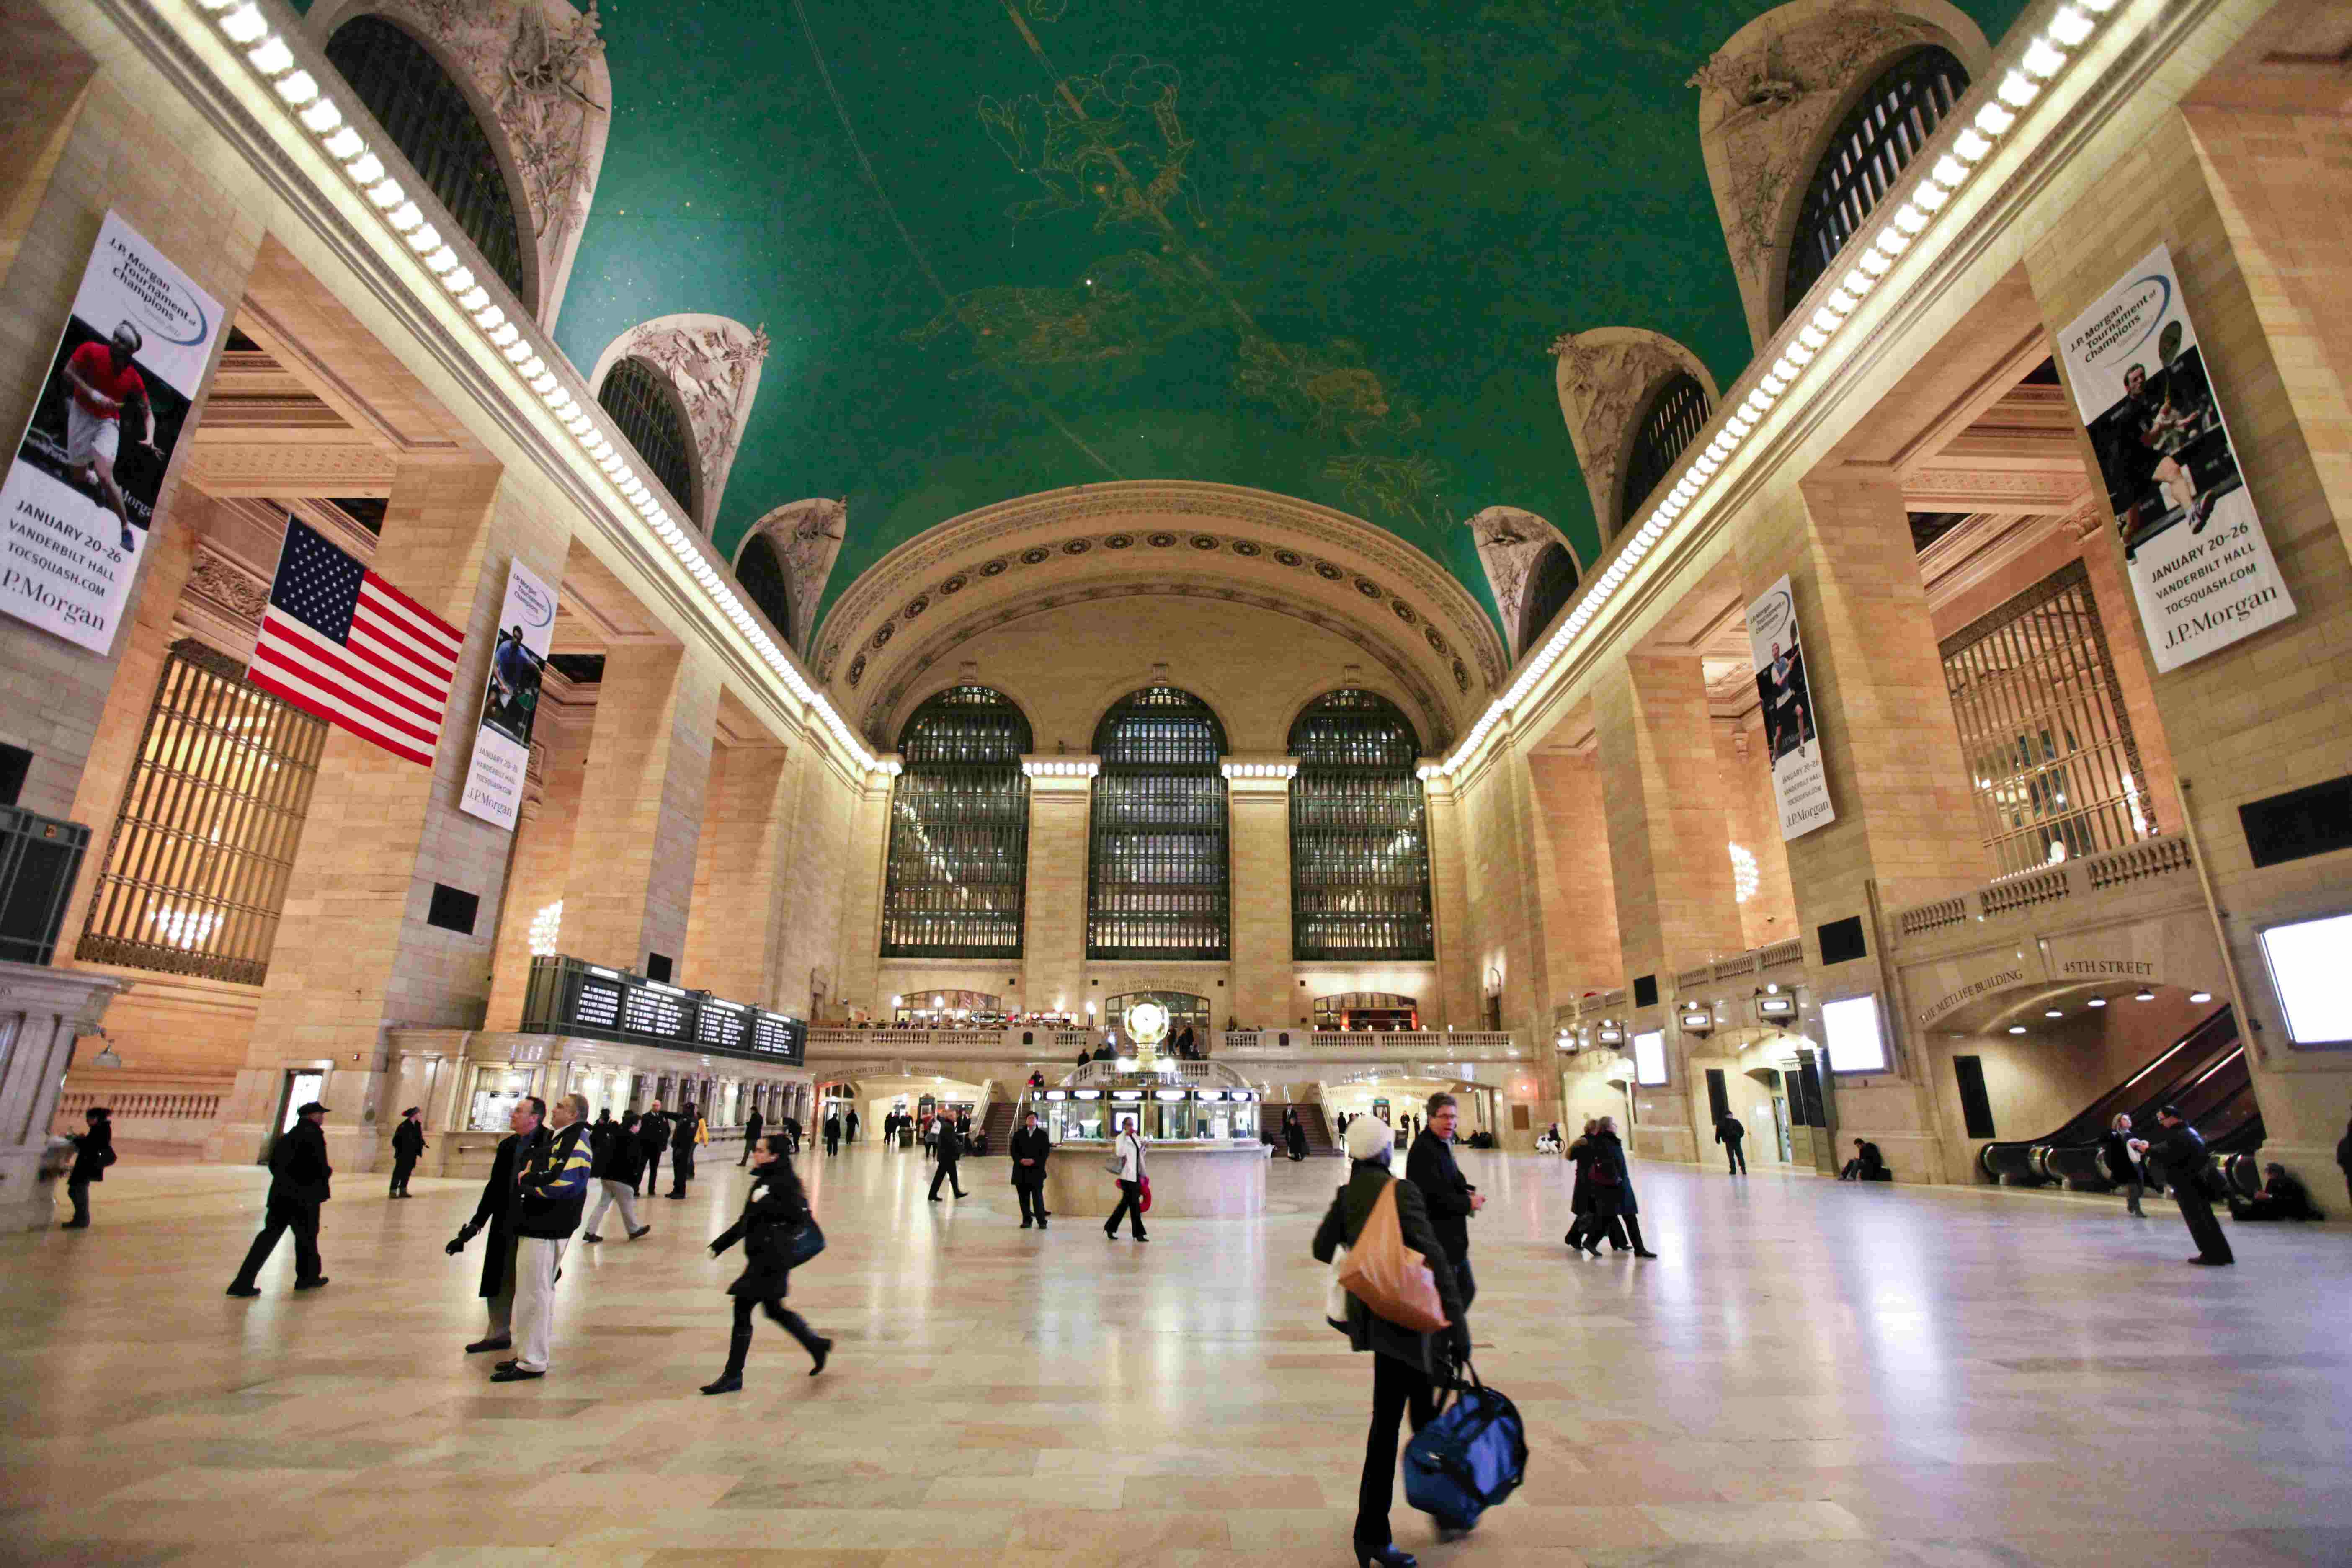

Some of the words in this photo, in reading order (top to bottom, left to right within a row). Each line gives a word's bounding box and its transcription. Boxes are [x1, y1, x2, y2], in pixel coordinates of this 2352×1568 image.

[108, 237, 126, 256] J.P.
[128, 252, 170, 292] Morgan
[124, 261, 188, 320] Tournament
[113, 266, 174, 322] Champions
[2085, 305, 2123, 339] Morgan
[2086, 294, 2148, 349] Tournament
[2085, 315, 2141, 363] Champions
[10, 517, 85, 565] VANDERBILT
[88, 560, 114, 582] HALL
[16, 500, 83, 541] JANUARY
[84, 535, 121, 563] 20-26
[2152, 544, 2205, 583] JANUARY
[2208, 521, 2249, 551] 20-26
[8, 541, 105, 597] TOCSQUASH.COM
[2156, 558, 2220, 599] VANDERBILT
[2224, 542, 2256, 564] HALL
[2165, 562, 2257, 615] TOCSQUASH.COM
[2165, 586, 2277, 650] J.P.Morgan
[467, 788, 512, 817] J.P.Morgan
[1786, 800, 1829, 828] J.P.Morgan
[2063, 960, 2096, 973] 45TH
[2099, 960, 2154, 975] STREET
[1918, 1006, 1936, 1024] THE
[1936, 985, 1974, 1011] METLIFE
[1974, 968, 2023, 994] BUILDING
